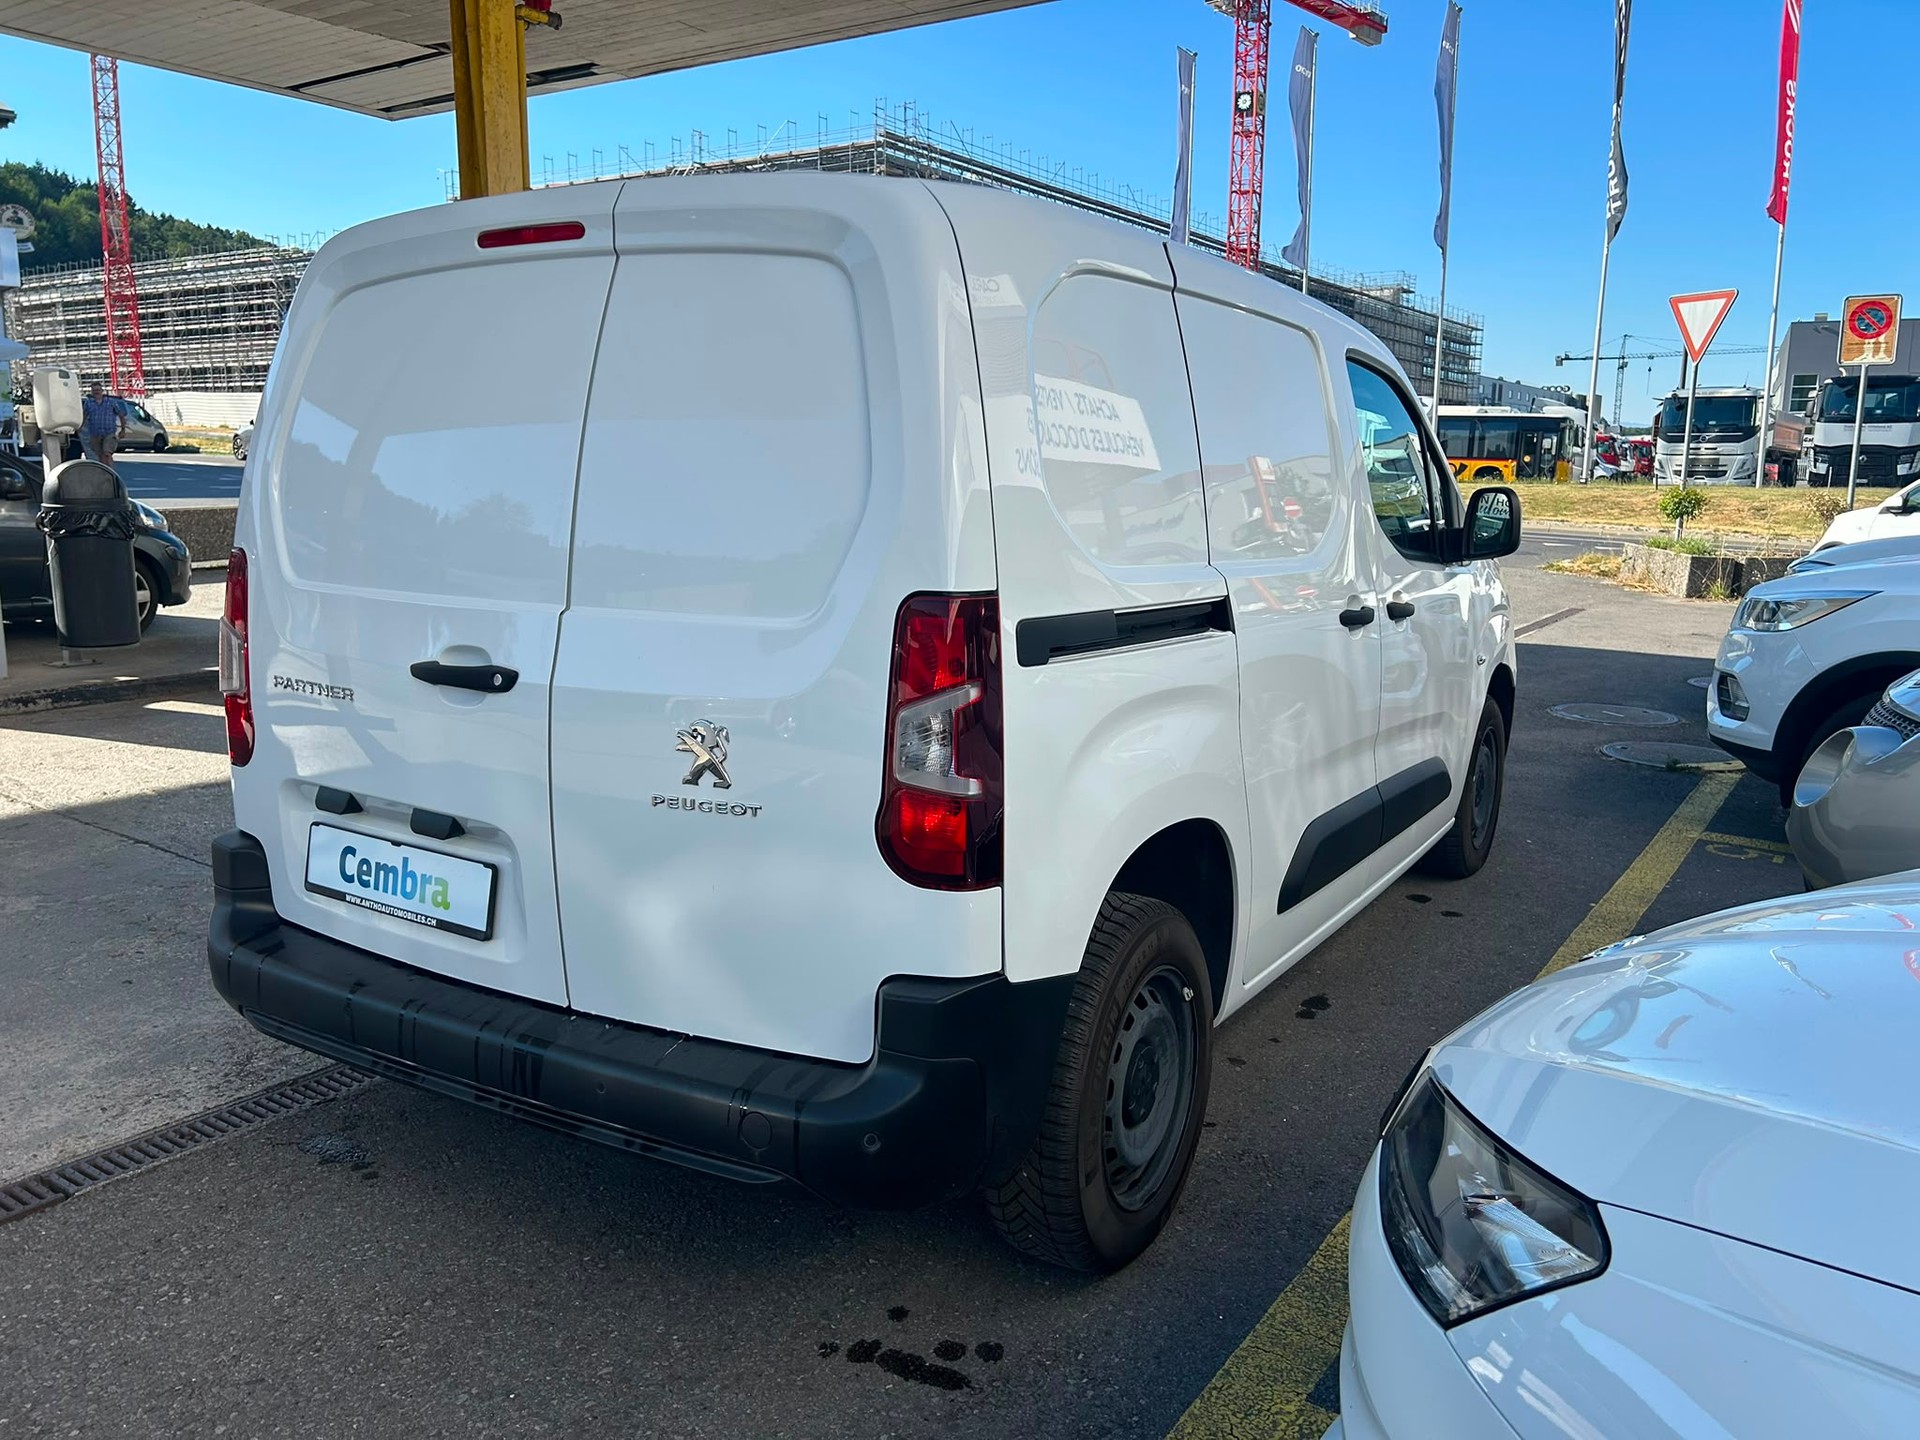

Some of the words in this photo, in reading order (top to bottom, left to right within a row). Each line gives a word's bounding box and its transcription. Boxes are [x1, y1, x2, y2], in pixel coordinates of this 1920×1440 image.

[273, 675, 355, 702] PARTNER
[651, 793, 763, 818] PEUGEOT
[339, 845, 451, 911] Cembra
[345, 893, 437, 927] WWW.ANTHOAUTOMOBILES.CH
